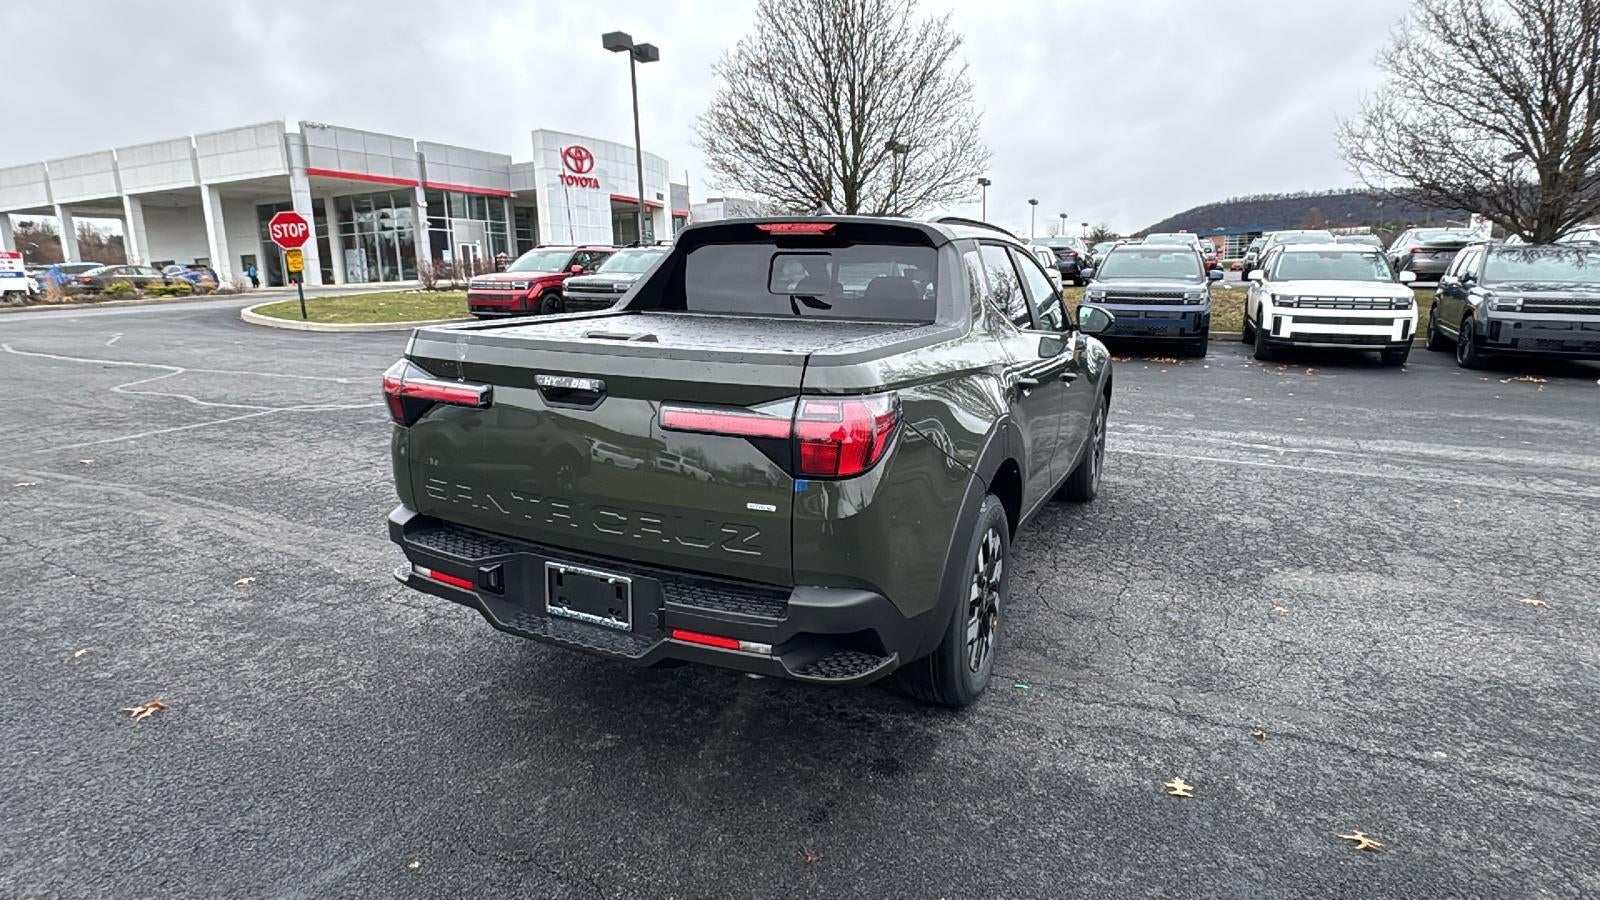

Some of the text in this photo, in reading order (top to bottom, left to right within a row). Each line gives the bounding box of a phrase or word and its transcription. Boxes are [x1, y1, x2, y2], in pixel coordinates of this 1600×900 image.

[559, 174, 600, 189] TOYOTA
[273, 223, 307, 239] STOP
[425, 477, 763, 556] SANTA CRUZ
